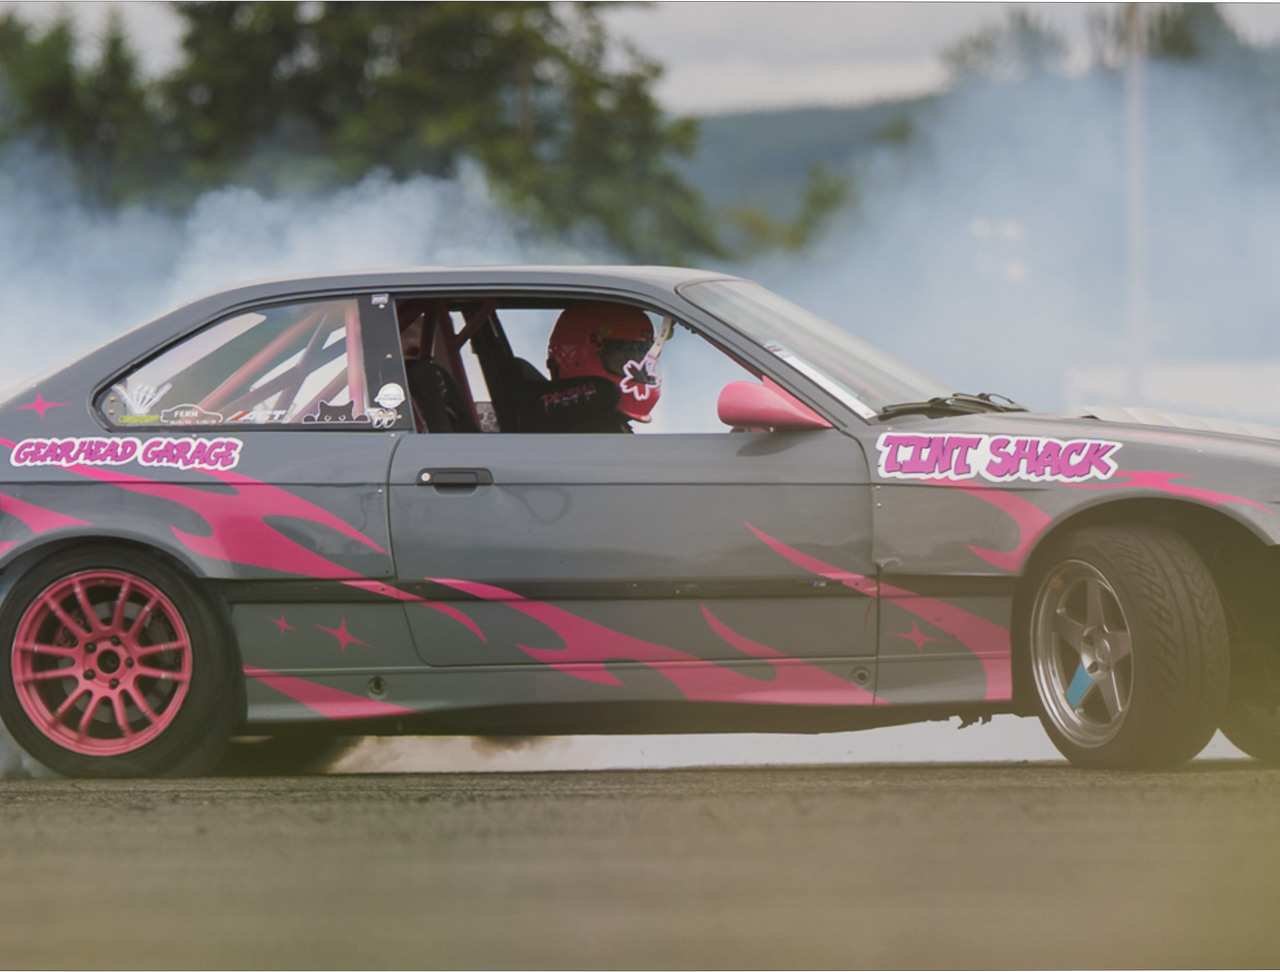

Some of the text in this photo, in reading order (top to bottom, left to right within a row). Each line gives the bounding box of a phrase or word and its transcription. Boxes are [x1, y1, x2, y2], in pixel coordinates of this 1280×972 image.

[174, 410, 198, 418] FERN
[14, 440, 239, 468] GEARHEAD GARAGE
[883, 435, 1115, 478] TINT SHACK
